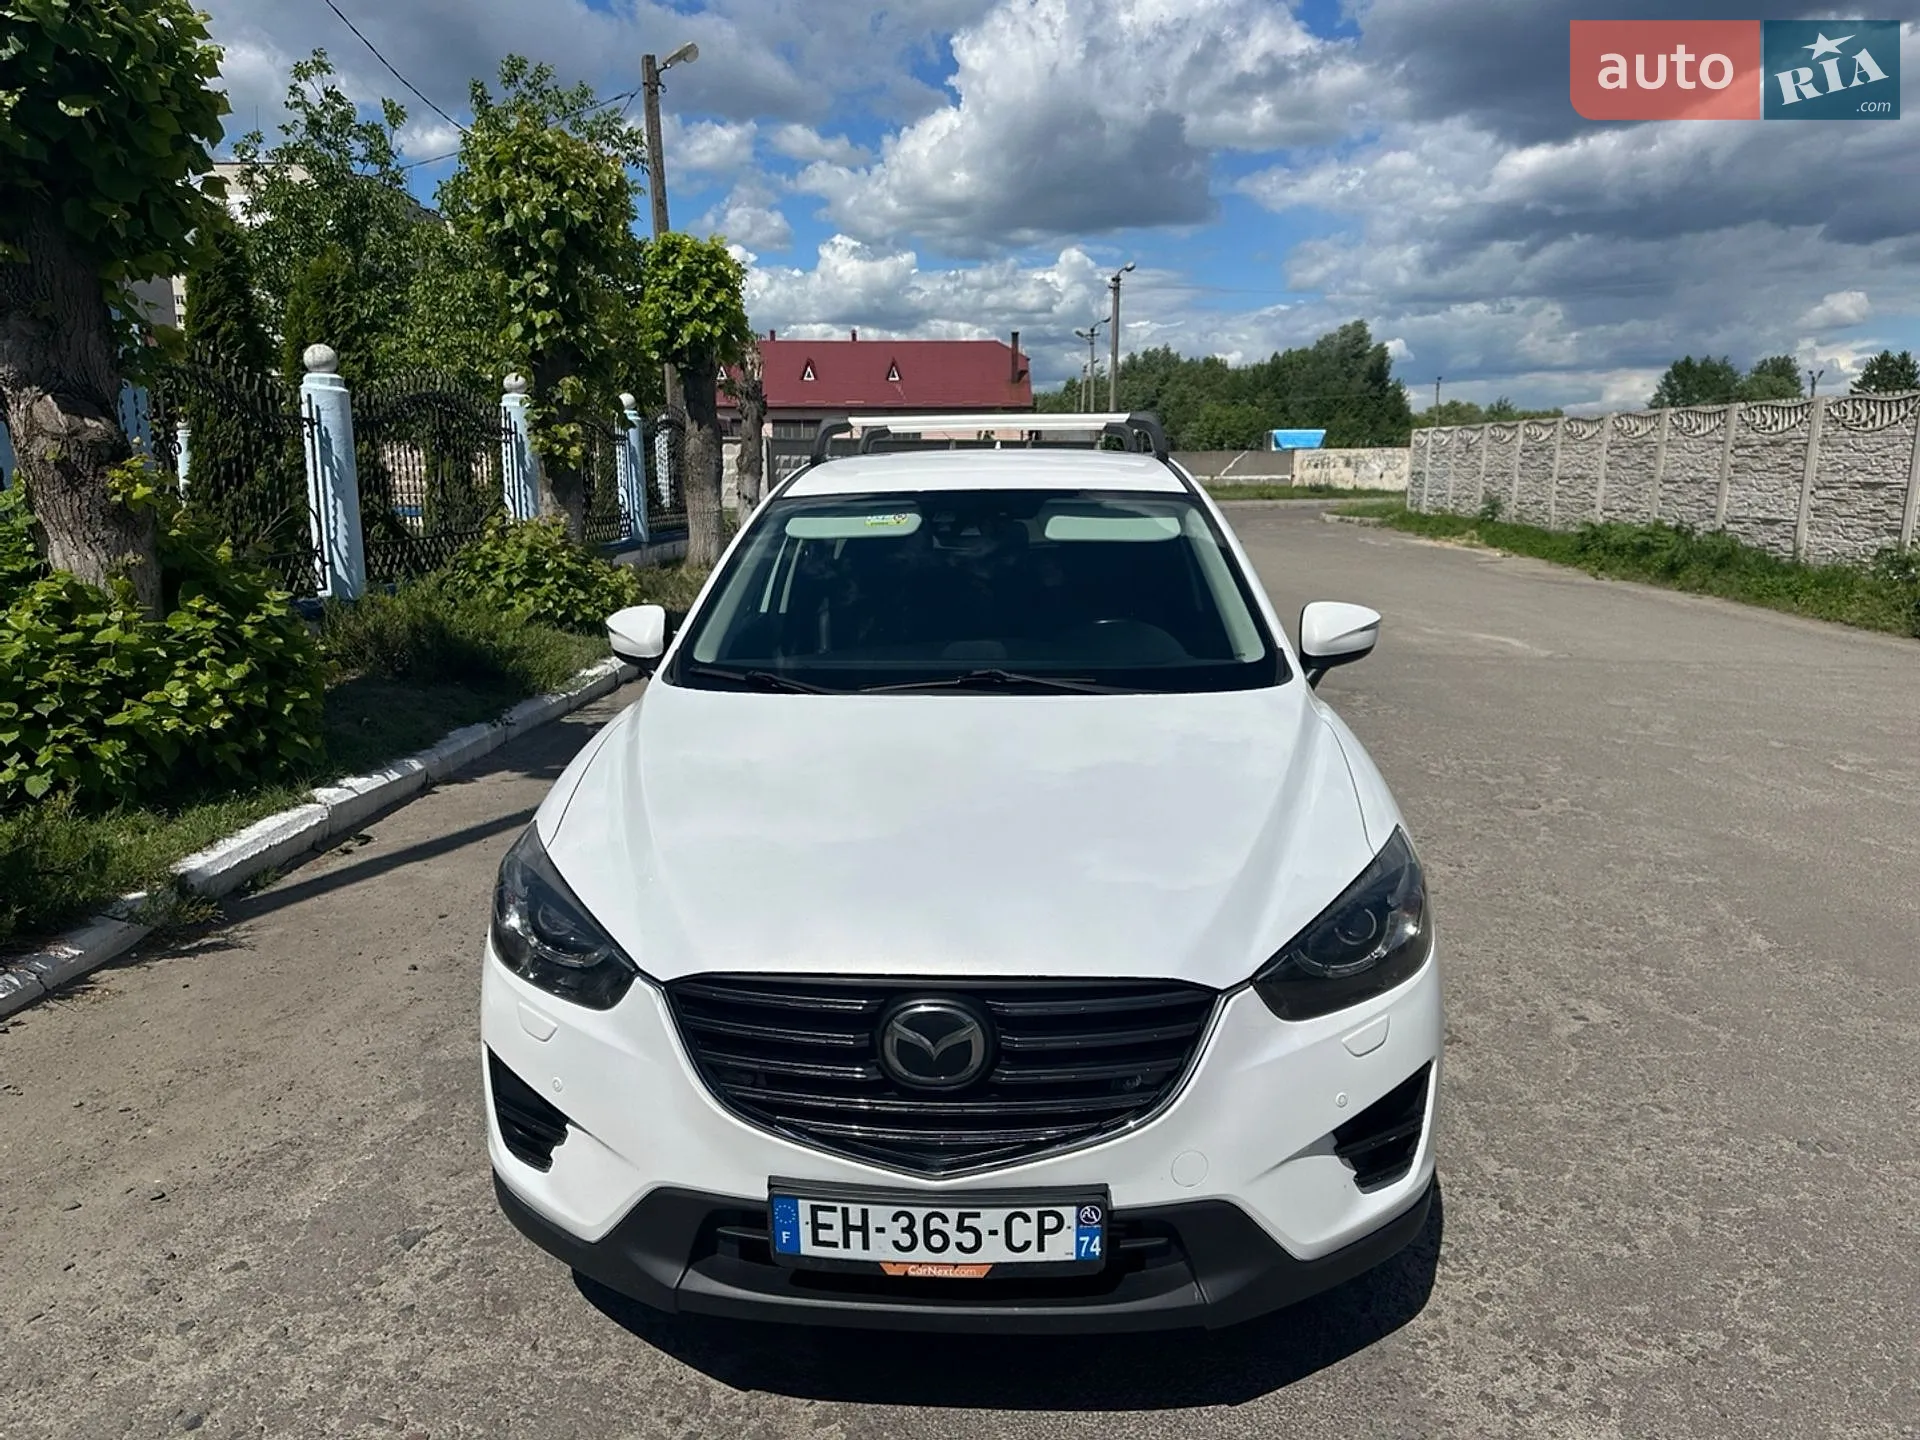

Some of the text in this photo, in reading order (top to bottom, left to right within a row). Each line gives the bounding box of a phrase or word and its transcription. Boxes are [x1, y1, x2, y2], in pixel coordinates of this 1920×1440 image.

[781, 1231, 791, 1244] F
[808, 1203, 1066, 1255] EH-365-CP
[1079, 1235, 1102, 1257] 74
[907, 1264, 977, 1277] CarNext.com
